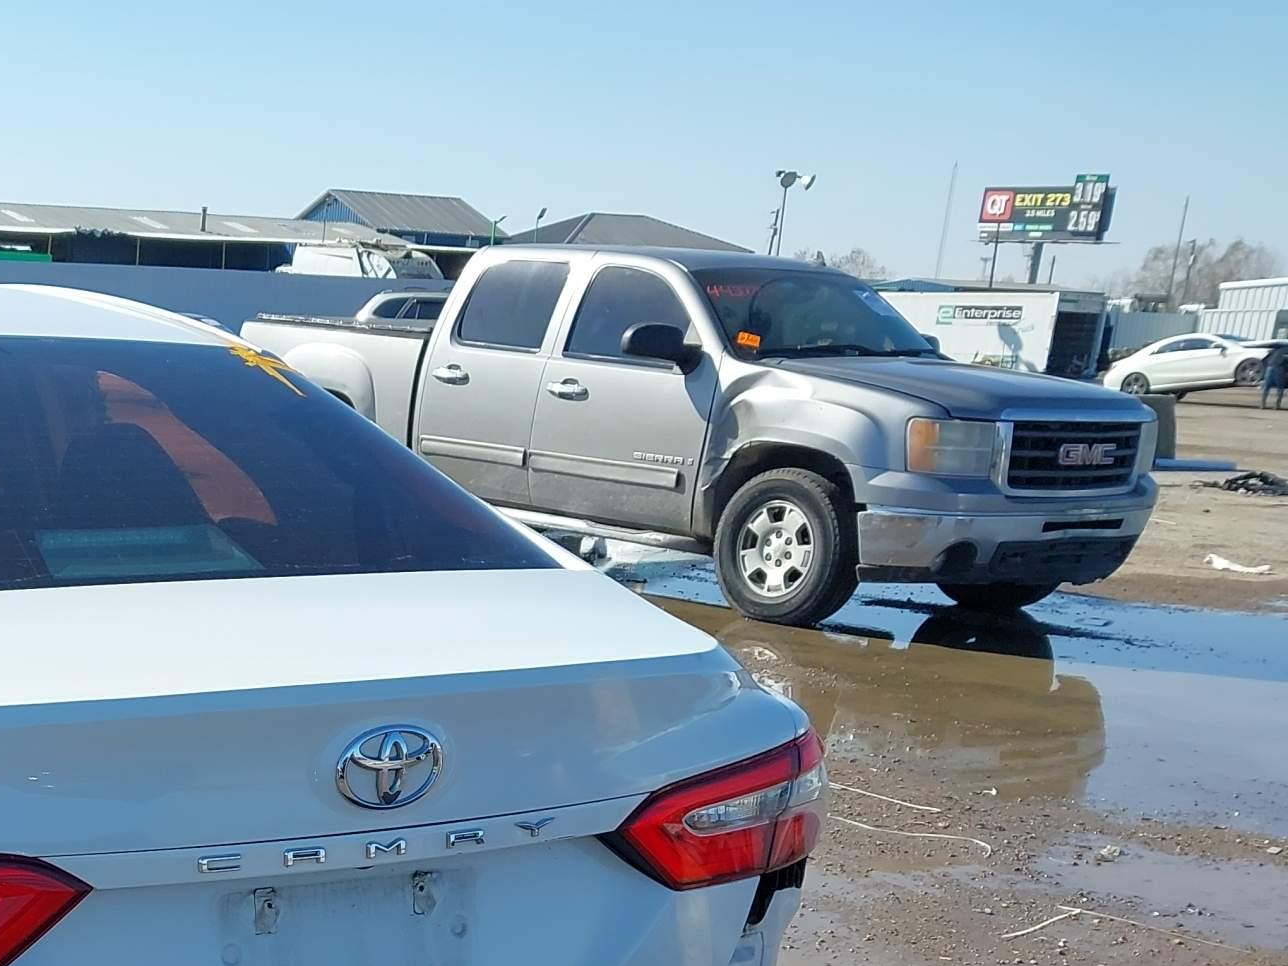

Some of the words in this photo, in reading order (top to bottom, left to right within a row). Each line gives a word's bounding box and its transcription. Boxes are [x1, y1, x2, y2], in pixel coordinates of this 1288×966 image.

[987, 195, 1010, 215] QT
[1014, 194, 1044, 206] EXIT
[1046, 193, 1071, 206] 273
[954, 306, 1022, 320] Enterprise
[632, 451, 684, 465] SIERRA
[1058, 443, 1117, 465] GMC
[197, 817, 555, 873] CAMRY
